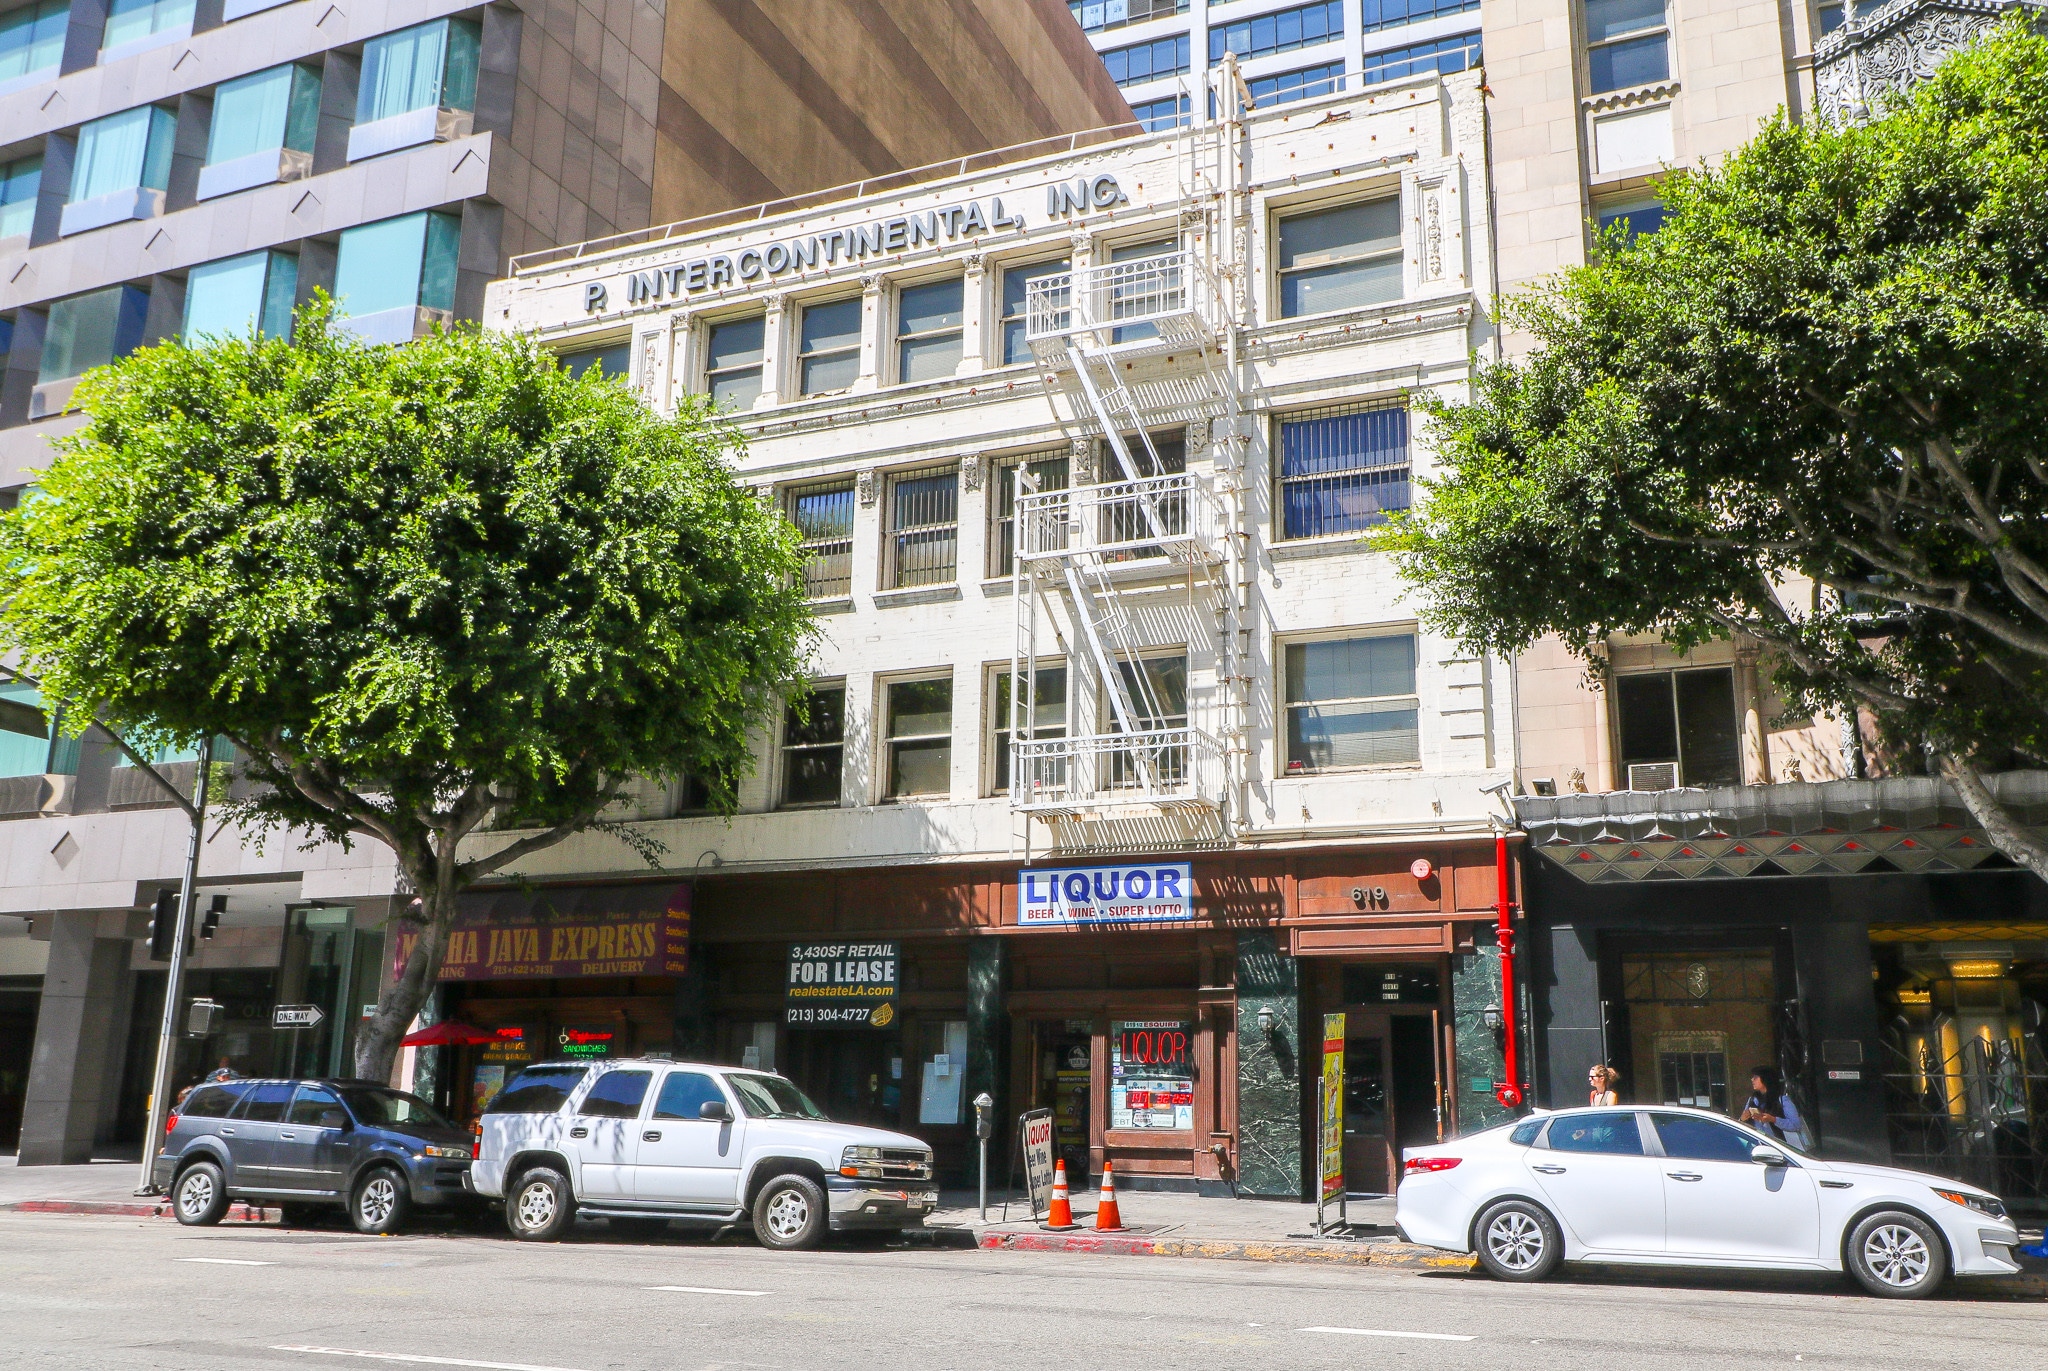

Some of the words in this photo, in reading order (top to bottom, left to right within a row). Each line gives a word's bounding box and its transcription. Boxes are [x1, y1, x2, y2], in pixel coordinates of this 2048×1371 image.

[585, 283, 605, 311] P.
[627, 196, 1023, 302] INTERCONTINENTAL,
[1046, 173, 1129, 216] INC.
[1026, 868, 1183, 904] LIQUOR
[1351, 886, 1386, 901] 619
[1027, 908, 1055, 920] BEER
[1067, 907, 1096, 918] WINE
[1108, 905, 1145, 917] SUPER
[1147, 903, 1183, 916] LOTTO
[401, 929, 478, 966] MHA
[485, 928, 540, 968] JAVA
[549, 922, 657, 962] EXPRESS
[792, 945, 846, 960] 3,430SF
[847, 944, 895, 957] RETAIL
[582, 961, 647, 975] DELIVERY
[790, 962, 828, 983] FOR
[834, 961, 895, 982] LEASE
[789, 985, 894, 997] realestateLA.com
[278, 1012, 293, 1021] ONE
[294, 1011, 309, 1021] WAY
[787, 1008, 814, 1023] (213)
[817, 1008, 870, 1021] 304-4727
[563, 1044, 608, 1053] SANDWICHES
[1122, 1031, 1187, 1064] LIQUOR
[1179, 1107, 1189, 1119] A
[1114, 1118, 1131, 1126] EBT
[1026, 1122, 1051, 1147] IQUOR
[1036, 1147, 1048, 1166] Wine
